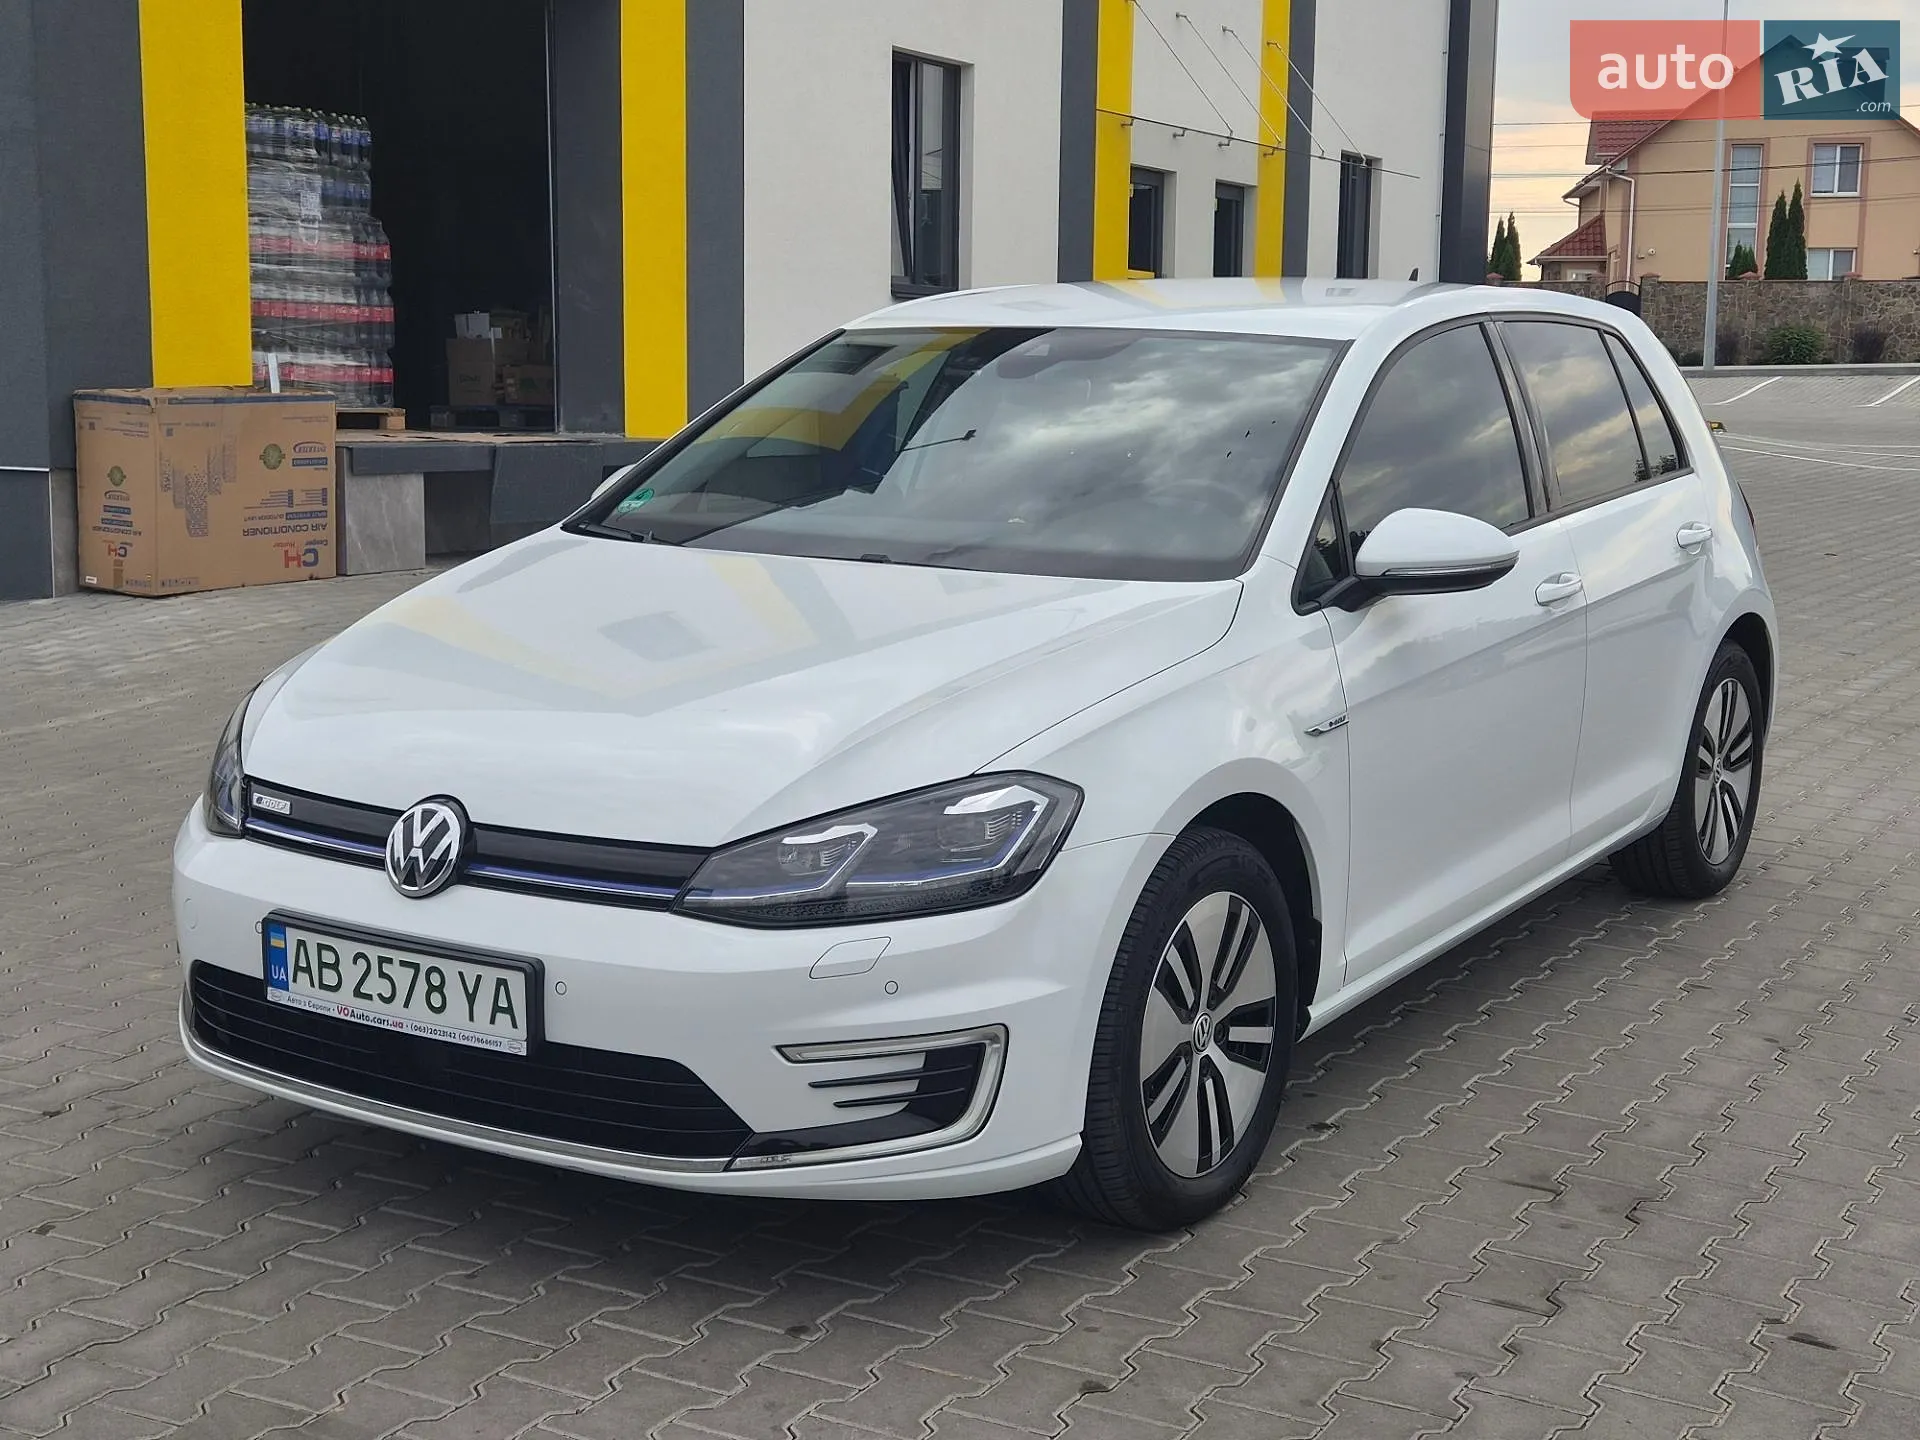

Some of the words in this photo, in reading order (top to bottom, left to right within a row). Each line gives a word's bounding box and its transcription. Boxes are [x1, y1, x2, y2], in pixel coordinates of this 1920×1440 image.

[242, 524, 309, 537] CONDITIONER
[310, 522, 328, 532] AIR
[108, 544, 128, 557] CH
[283, 547, 319, 569] CH
[271, 965, 287, 982] UA
[292, 938, 343, 993] AB
[352, 951, 448, 1015] 2578
[457, 970, 519, 1030] YA
[287, 995, 302, 1005] Авто
[336, 1005, 404, 1029] VOAuto.cars.ua
[410, 1022, 457, 1040] (063)2023142
